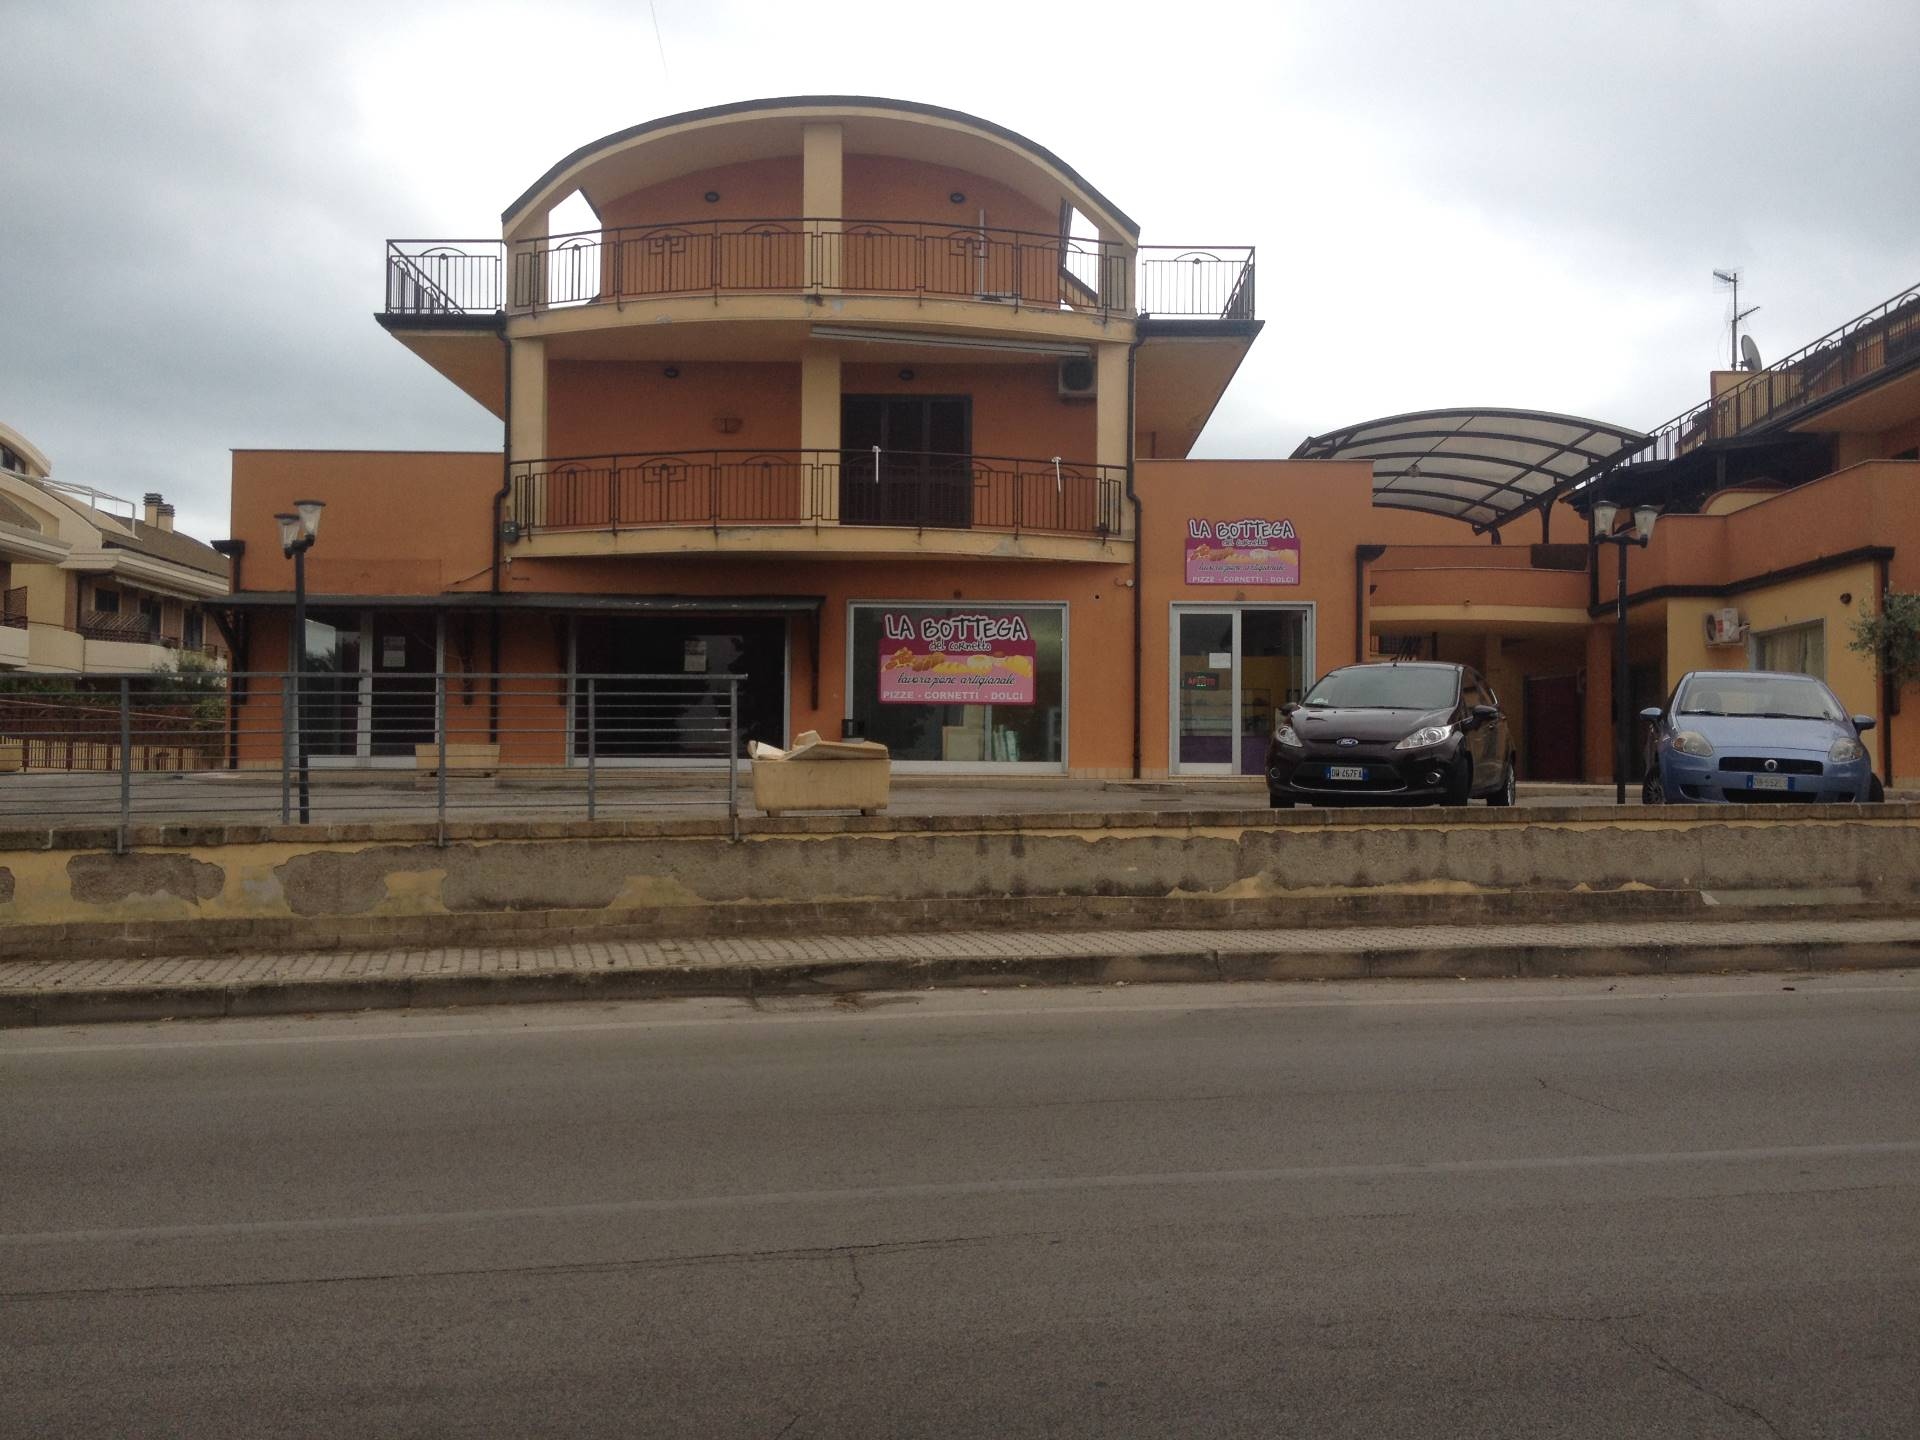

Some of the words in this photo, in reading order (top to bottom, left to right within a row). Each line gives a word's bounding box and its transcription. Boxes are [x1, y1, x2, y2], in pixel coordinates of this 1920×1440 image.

[1189, 519, 1211, 538] LA
[1216, 520, 1295, 539] BOTTEGA
[885, 614, 916, 639] LA
[921, 615, 1028, 641] BOTTEGA
[897, 672, 956, 688] lavorazione
[960, 672, 1015, 688] artigianale
[883, 691, 914, 699] PIZZE
[924, 691, 979, 699] CORNETTI
[991, 691, 1023, 700] DOLCI
